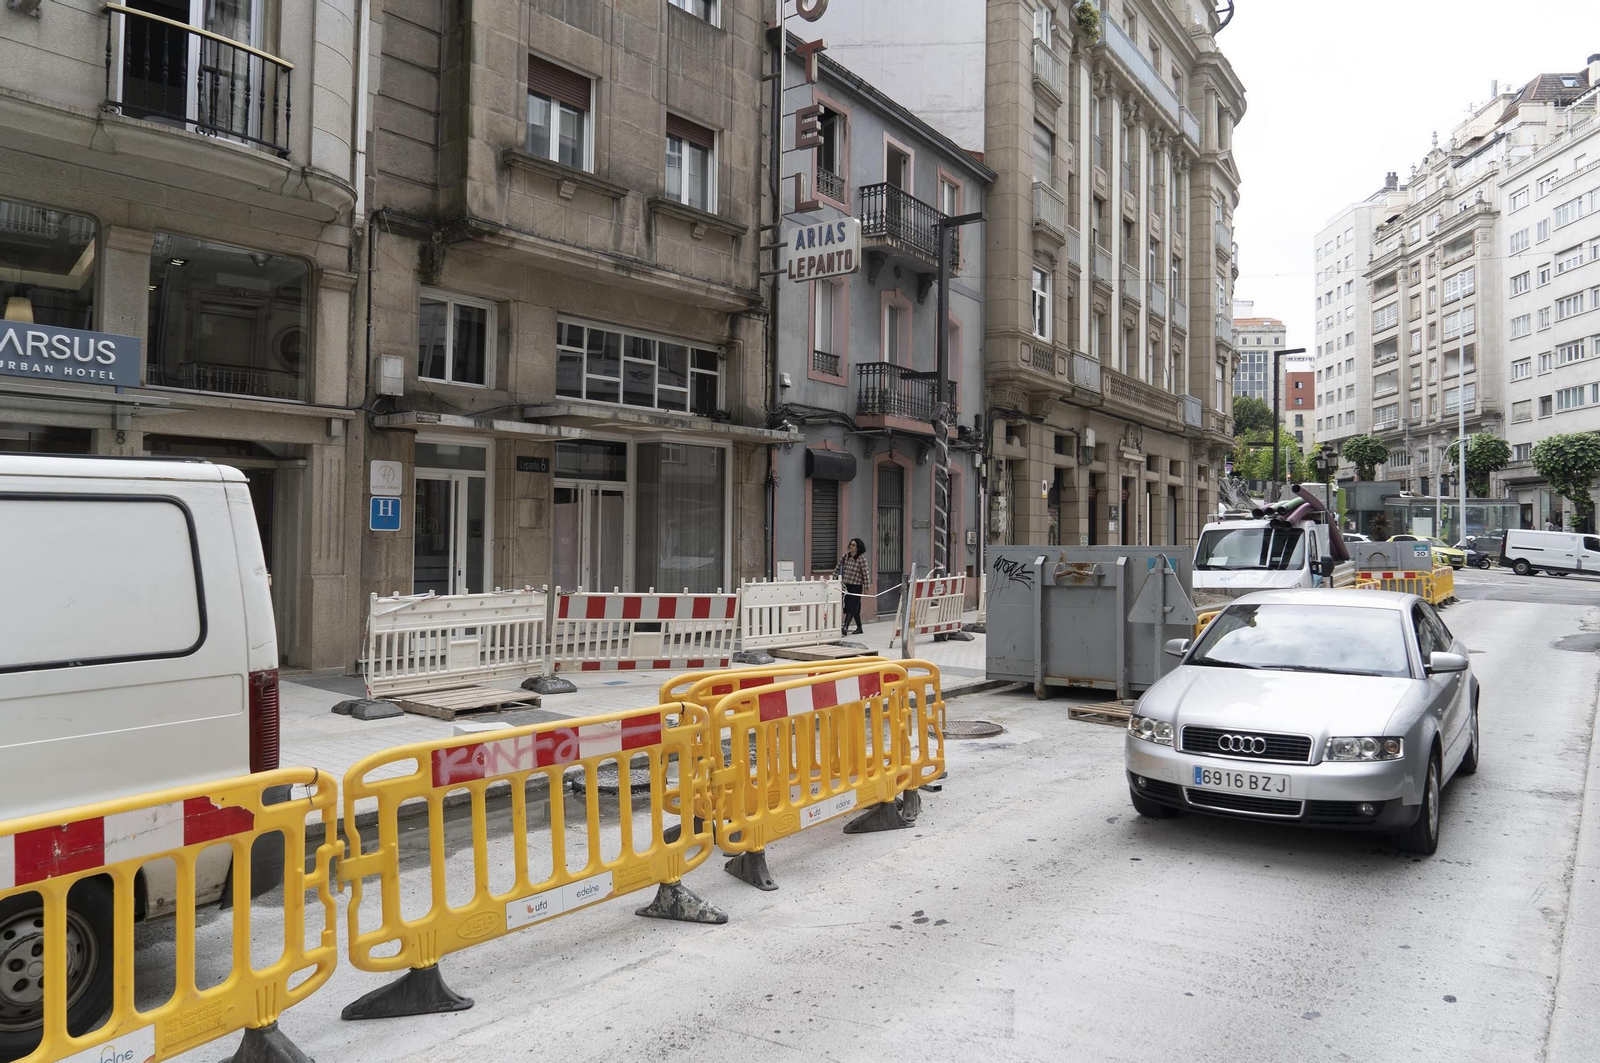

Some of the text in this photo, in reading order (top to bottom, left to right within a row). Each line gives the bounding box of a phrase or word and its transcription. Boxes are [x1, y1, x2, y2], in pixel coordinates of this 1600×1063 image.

[795, 221, 847, 251] ARIAS
[787, 248, 853, 280] LEPANTO
[0, 328, 116, 365] ARSUS
[64, 366, 115, 380] HOTEL
[115, 431, 126, 445] 8
[540, 458, 547, 471] 6
[377, 499, 394, 517] H
[1202, 769, 1286, 793] 6916 BZJ
[535, 900, 548, 912] ufd
[463, 913, 496, 936] JSP
